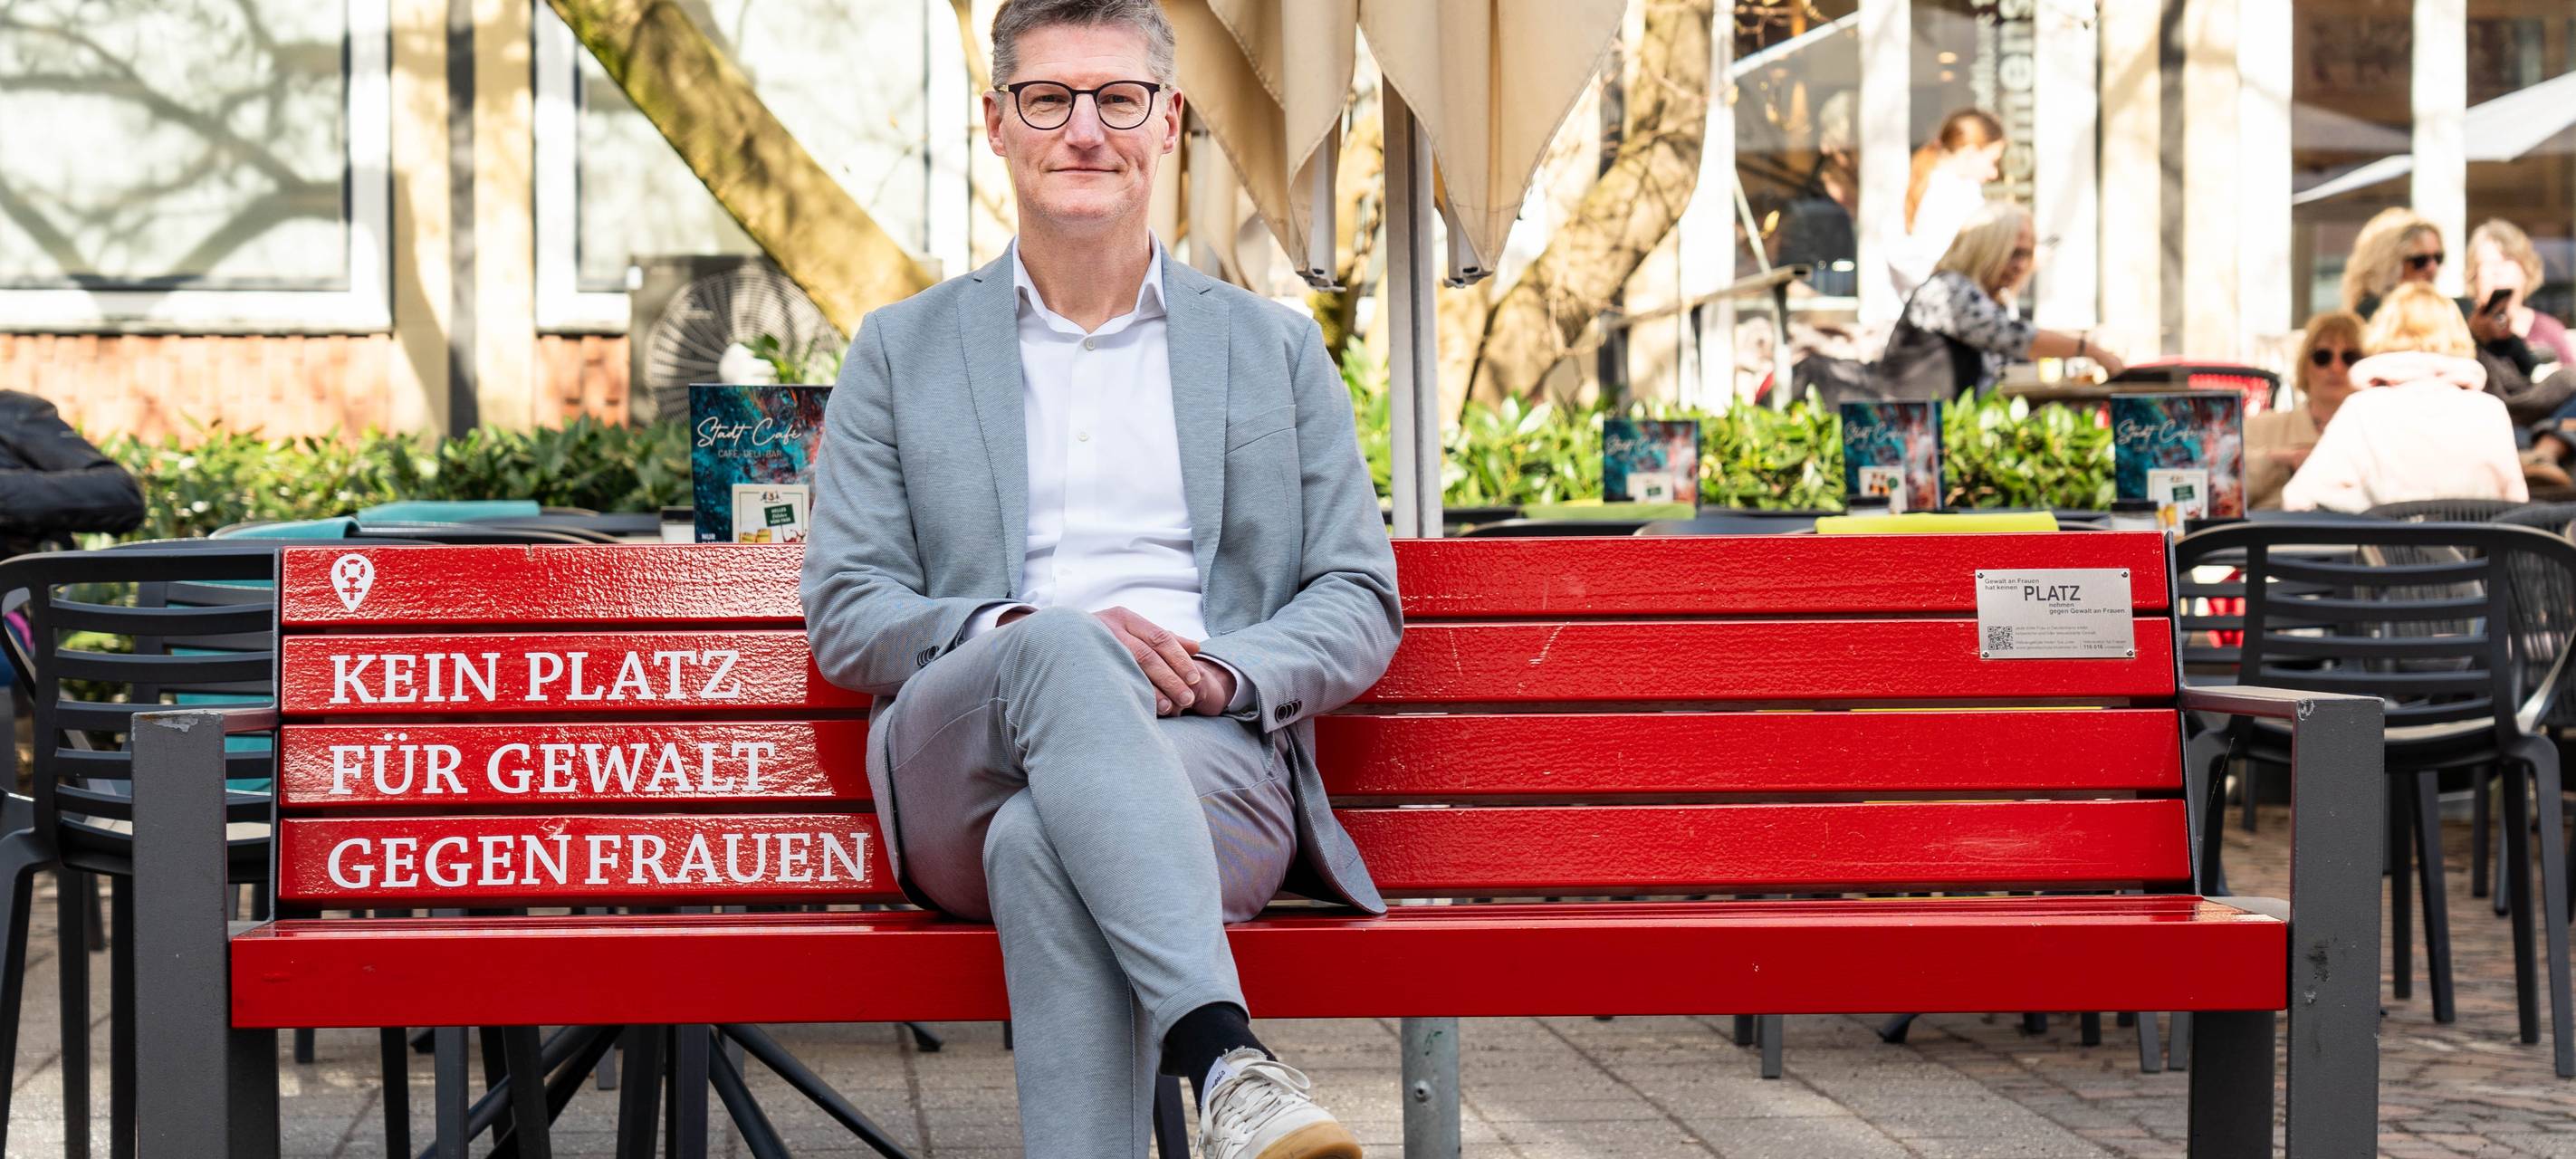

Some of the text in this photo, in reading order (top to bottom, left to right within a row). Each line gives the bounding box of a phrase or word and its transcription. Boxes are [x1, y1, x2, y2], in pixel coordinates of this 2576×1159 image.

[697, 416, 802, 447] Stadt Café
[2024, 585, 2081, 601] PLATZ
[330, 649, 742, 705] KEIN PLATZ
[329, 732, 776, 795] FÜR GEWALT
[327, 831, 870, 888] GEGEN FRAUEN
